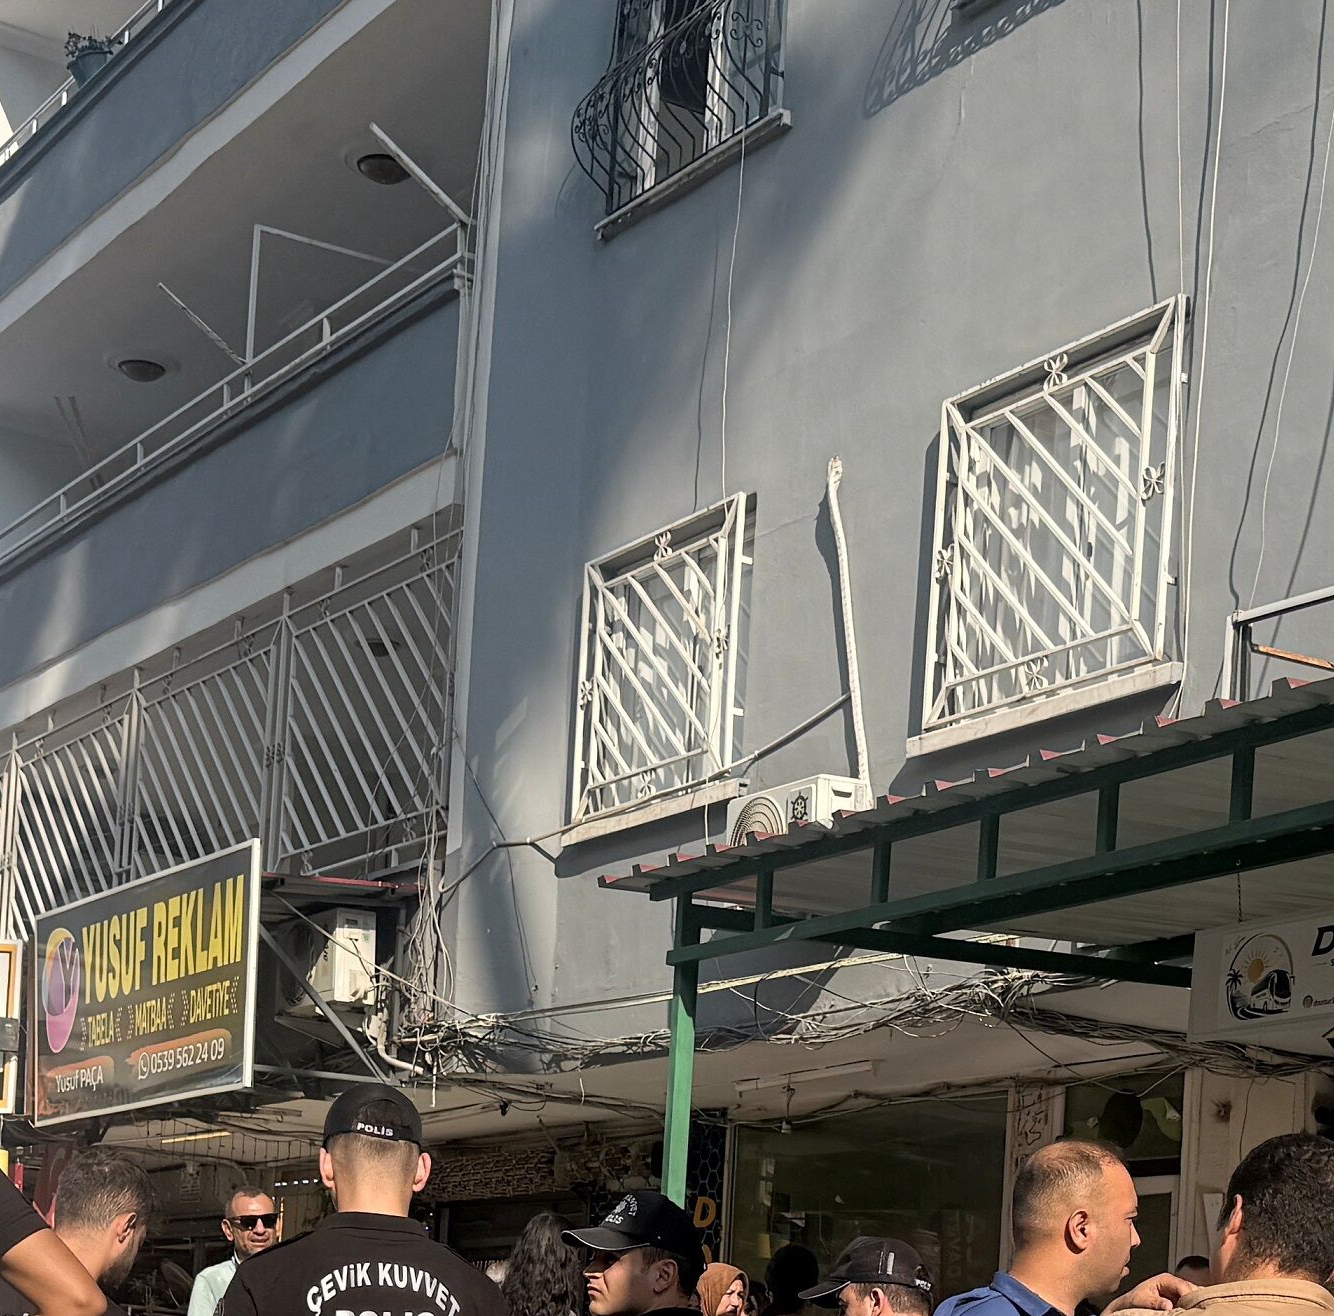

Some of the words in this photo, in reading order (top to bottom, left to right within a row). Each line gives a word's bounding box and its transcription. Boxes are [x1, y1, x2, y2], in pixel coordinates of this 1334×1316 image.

[81, 906, 148, 1004] YUSUF
[151, 874, 245, 986] REKLAM
[87, 1010, 115, 1048] TABELA
[134, 996, 167, 1037] MATBAA
[150, 1049, 175, 1074] 0539
[176, 1044, 194, 1069] 562
[195, 1041, 209, 1065] 24
[210, 1038, 225, 1062] 09
[54, 1069, 80, 1094] Yusuf
[80, 1064, 104, 1092] PAÇA
